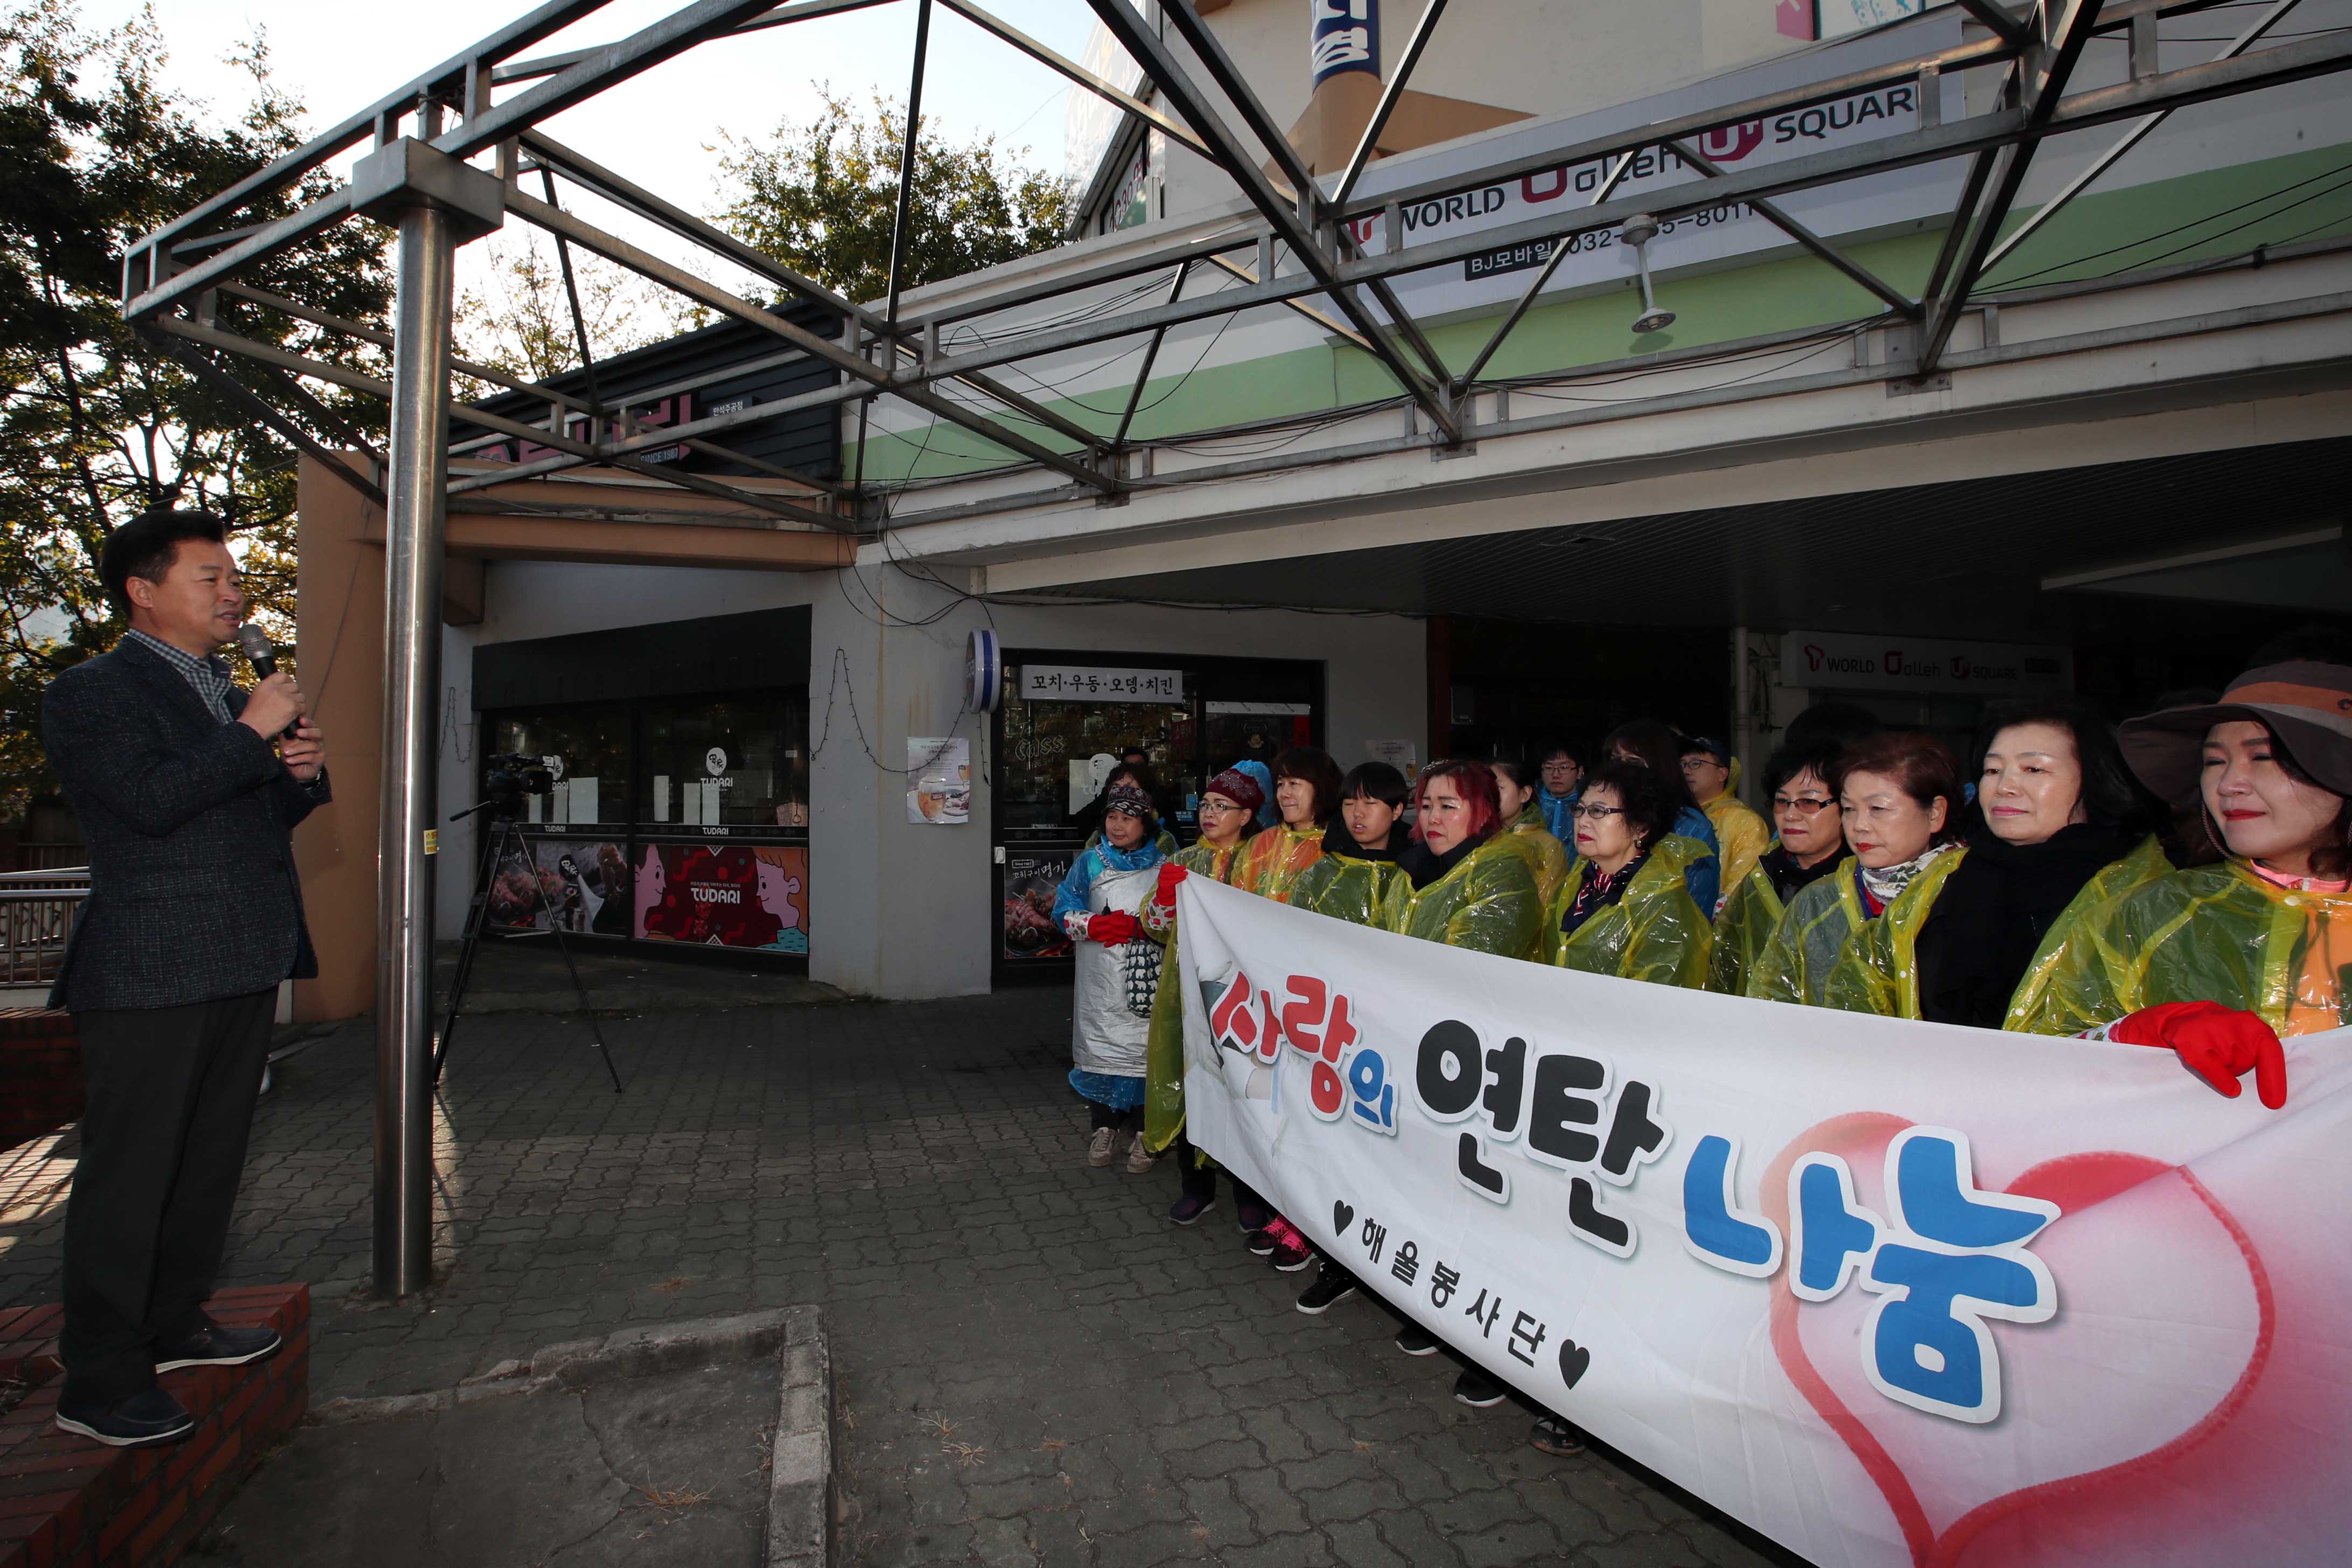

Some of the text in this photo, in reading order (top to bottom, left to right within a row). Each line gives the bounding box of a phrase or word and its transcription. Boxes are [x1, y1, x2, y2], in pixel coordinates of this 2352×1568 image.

[1774, 87, 1919, 144] SQUAR
[1472, 240, 1552, 273] BJ모바일
[663, 448, 678, 460] 1987
[1827, 657, 1875, 674] WORLD
[1972, 664, 2019, 681] SQUARE
[700, 777, 734, 787] TUDARI
[702, 827, 729, 836] TUDARI
[1012, 860, 1067, 880] 꼬치구이 명가
[690, 887, 740, 904] TUDARI
[1210, 969, 2049, 1409] 사랑의 연탄 나눔
